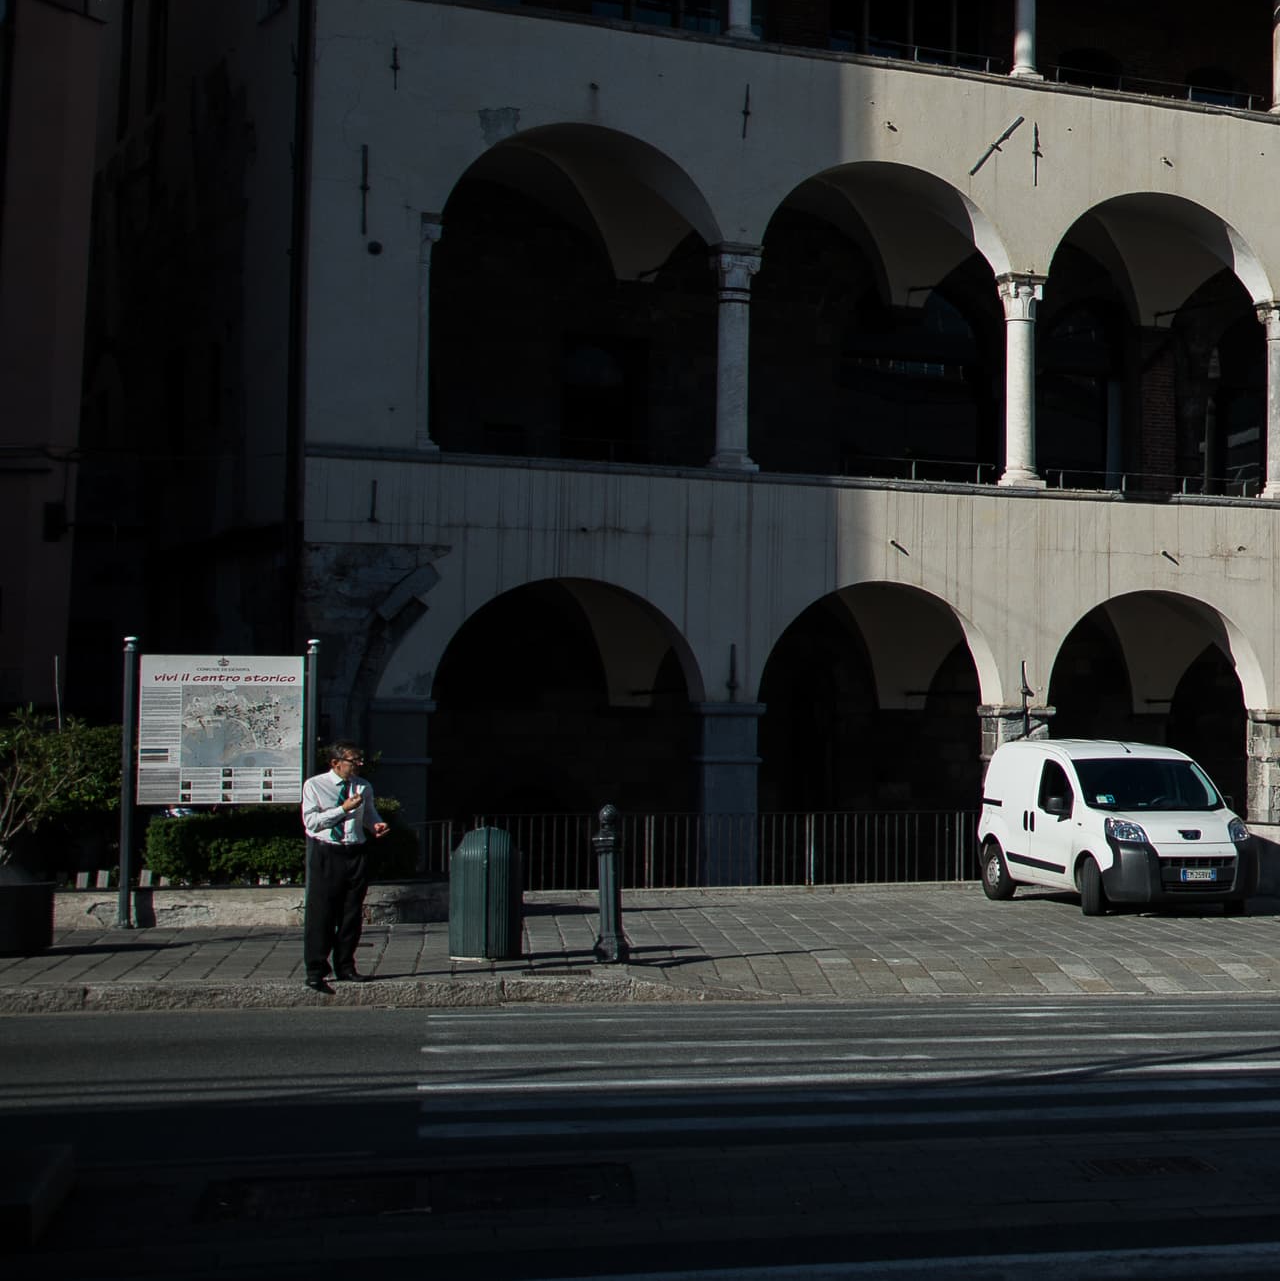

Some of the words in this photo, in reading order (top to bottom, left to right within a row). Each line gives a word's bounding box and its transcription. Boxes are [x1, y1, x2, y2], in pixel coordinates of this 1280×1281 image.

[154, 673, 177, 682] vivi
[181, 673, 190, 682] il
[192, 673, 241, 682] centro
[243, 674, 296, 683] storico
